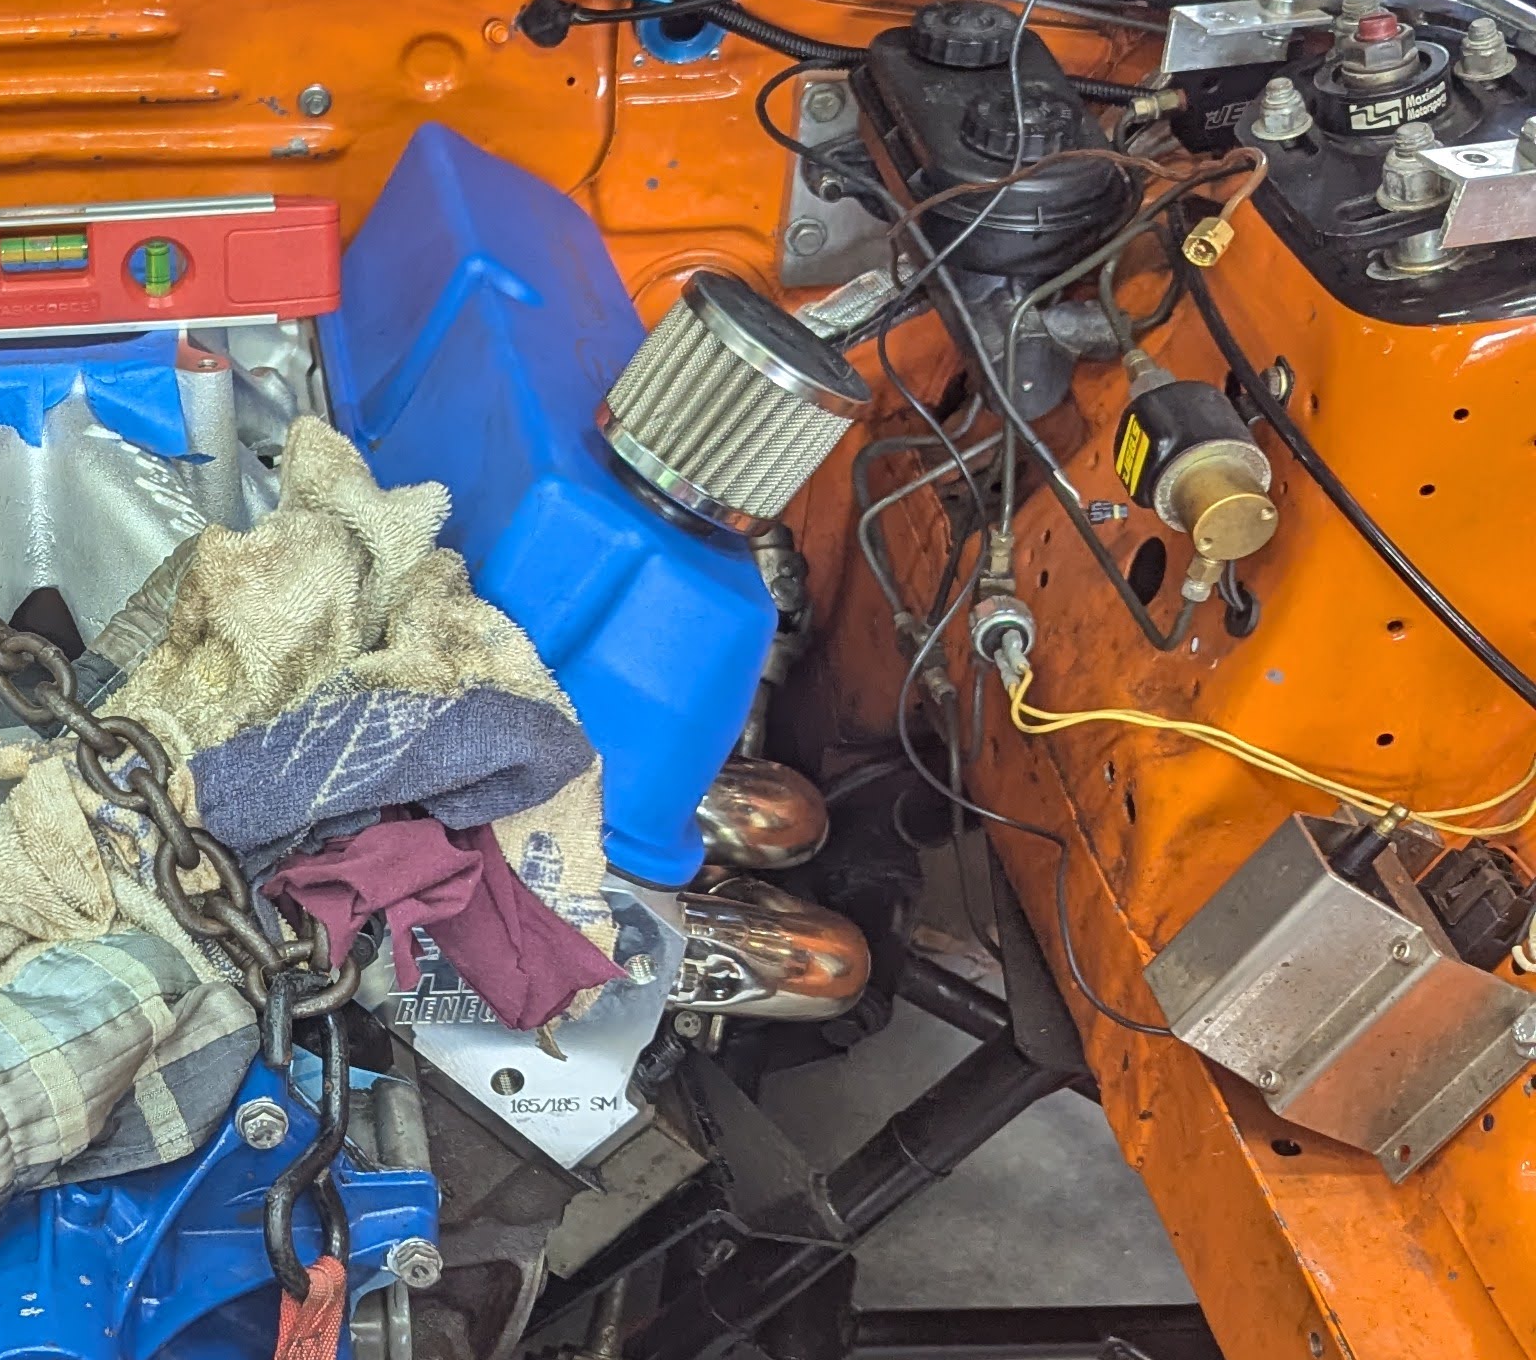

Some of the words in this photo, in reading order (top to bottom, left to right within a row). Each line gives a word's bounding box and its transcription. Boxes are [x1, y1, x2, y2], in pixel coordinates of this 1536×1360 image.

[1205, 100, 1250, 130] JE
[394, 995, 497, 1025] RENE
[510, 1097, 580, 1114] 165/185
[589, 1096, 617, 1111] SM
